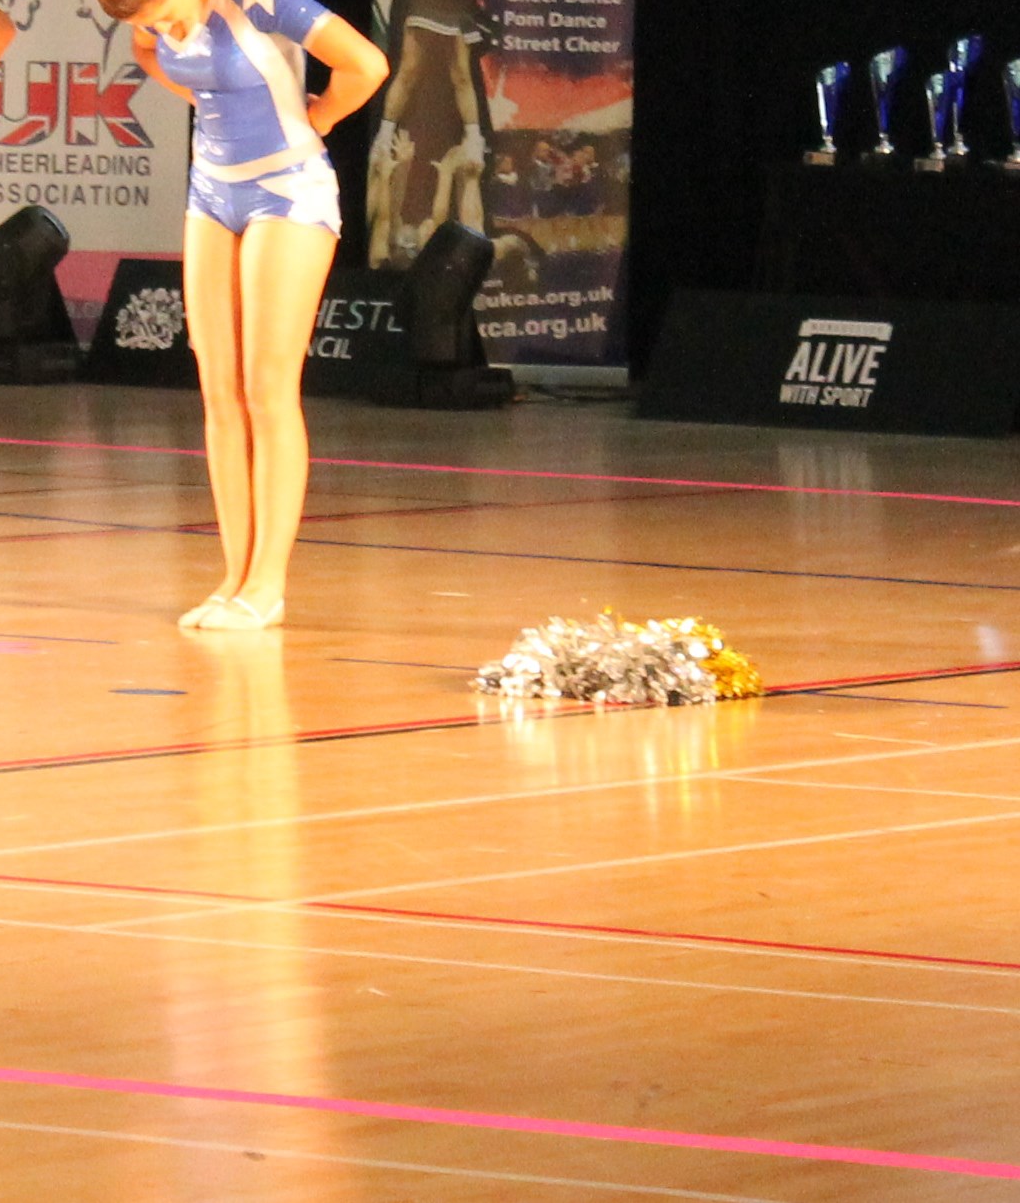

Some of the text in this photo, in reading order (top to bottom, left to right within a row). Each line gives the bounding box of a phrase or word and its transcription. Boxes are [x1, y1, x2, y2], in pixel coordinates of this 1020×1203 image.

[503, 10, 608, 29] Pom Dance
[502, 34, 621, 53] Street Cheer
[784, 341, 887, 385] ALIVE
[779, 384, 874, 408] WITH SPORT
